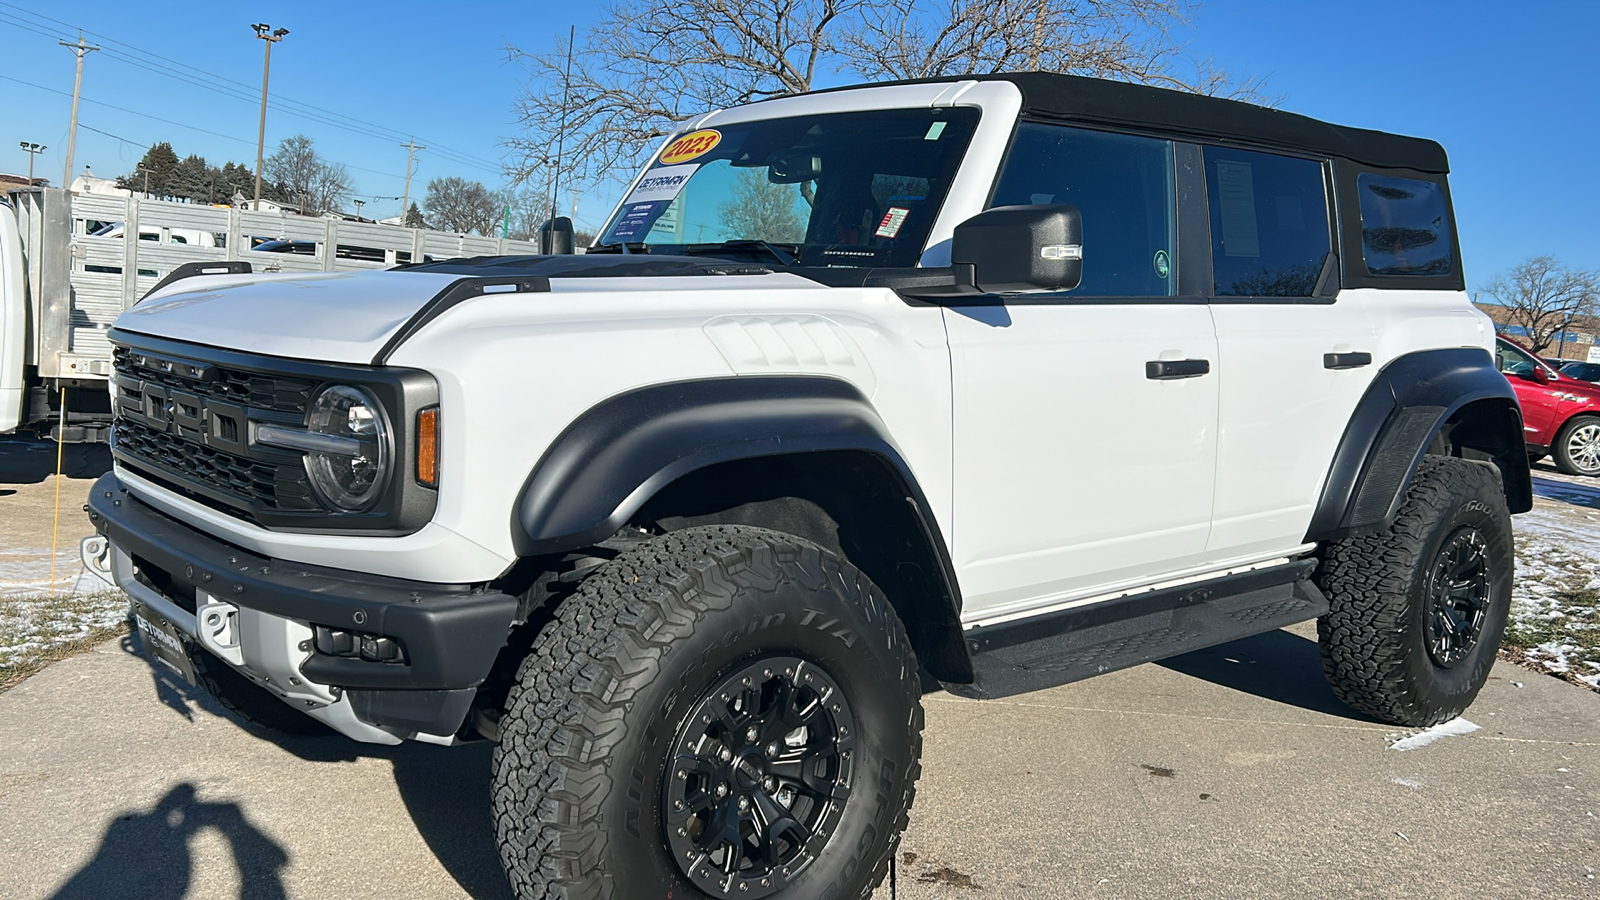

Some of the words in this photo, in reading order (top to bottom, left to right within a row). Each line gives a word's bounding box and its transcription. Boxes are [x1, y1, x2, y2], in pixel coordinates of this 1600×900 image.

[662, 135, 717, 159] 2023
[116, 374, 247, 458] FORD
[799, 607, 861, 649] T/A
